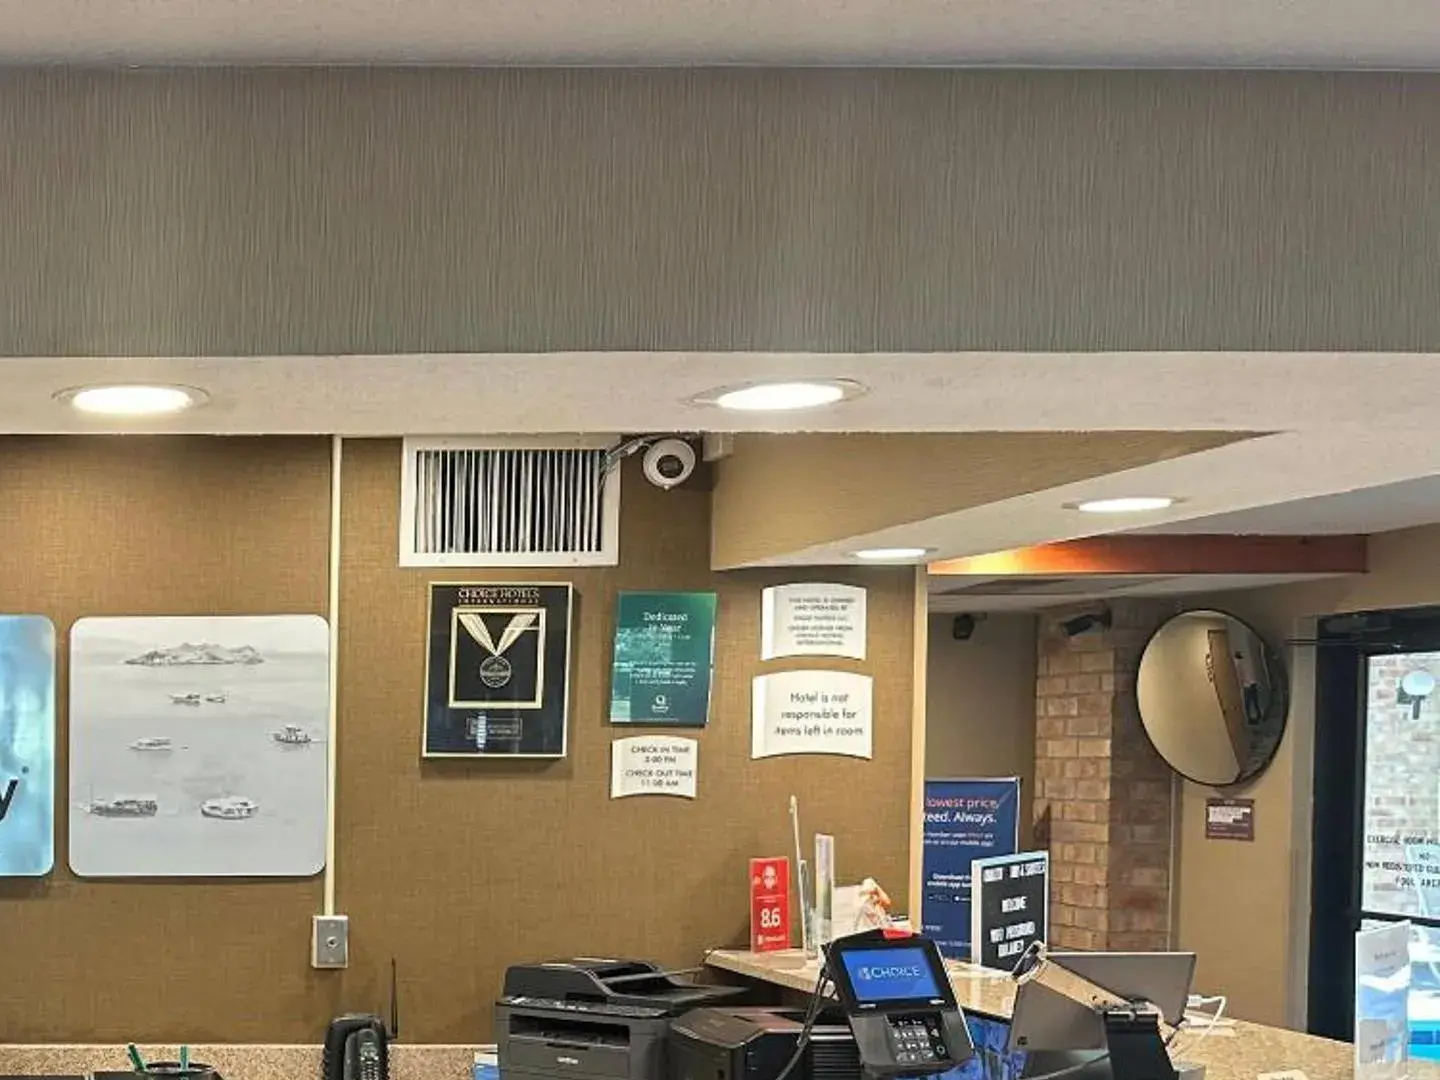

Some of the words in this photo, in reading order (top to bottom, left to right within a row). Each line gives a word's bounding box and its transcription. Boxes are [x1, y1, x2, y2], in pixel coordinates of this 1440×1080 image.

[790, 691, 819, 703] Hotel
[821, 692, 828, 703] is
[831, 693, 849, 703] not
[781, 708, 839, 721] responsible
[842, 708, 857, 719] for
[774, 725, 801, 736] items
[804, 725, 821, 736] left
[823, 725, 833, 736] in
[836, 727, 863, 736] room
[926, 796, 964, 807] lowest
[953, 811, 997, 826] Always.
[760, 907, 781, 928] 8.6
[871, 967, 921, 979] CHOICE
